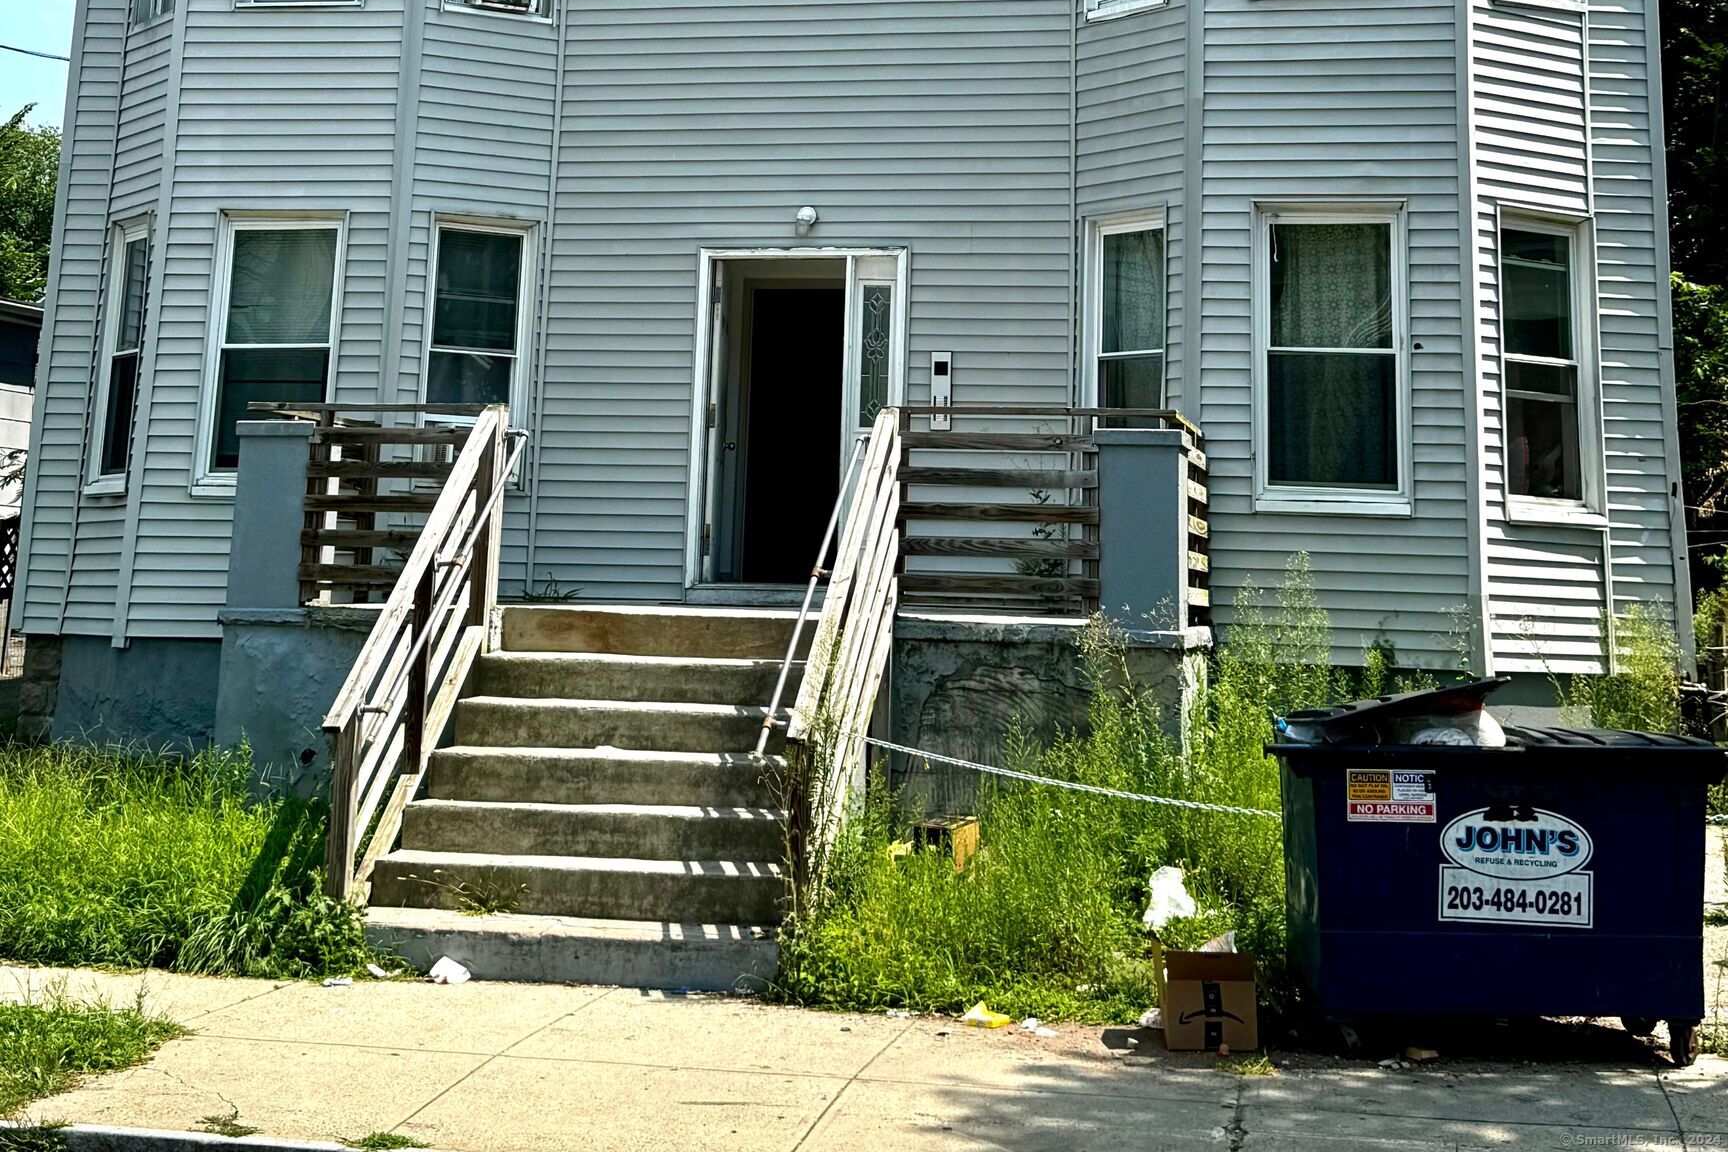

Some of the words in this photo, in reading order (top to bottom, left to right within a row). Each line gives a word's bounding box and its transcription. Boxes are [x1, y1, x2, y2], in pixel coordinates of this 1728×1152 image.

[1351, 773, 1388, 782] CAUTION
[1395, 774, 1424, 783] NOTIC
[1356, 804, 1374, 814] NO
[1376, 804, 1427, 815] PARKING
[1455, 825, 1580, 857] JOHN'S
[1474, 856, 1505, 865] REFUSE
[1513, 859, 1558, 868] RECYCLING
[1447, 885, 1582, 916] 203-484-0281
